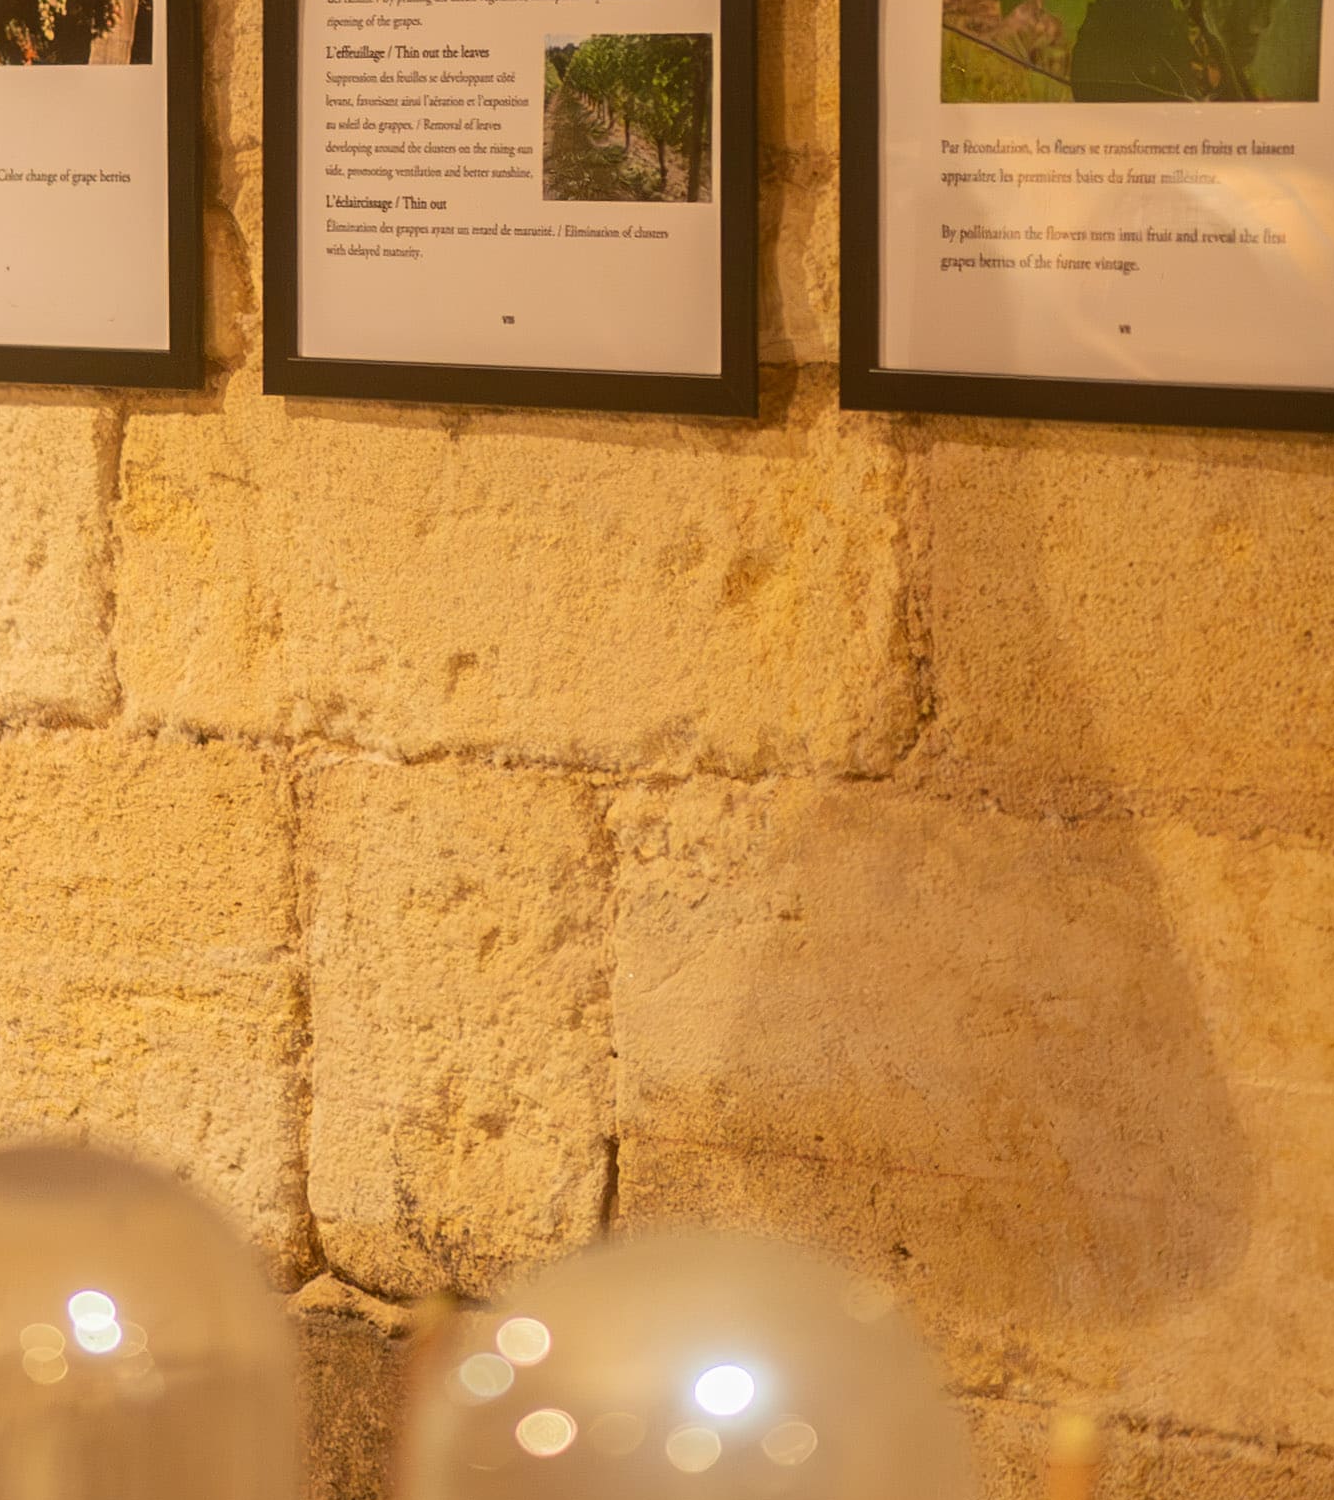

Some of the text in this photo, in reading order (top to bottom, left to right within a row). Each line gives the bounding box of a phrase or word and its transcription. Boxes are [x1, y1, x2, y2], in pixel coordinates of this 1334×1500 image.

[325, 45, 385, 62] L'effeuillage
[394, 45, 419, 58] Thin
[422, 49, 439, 58] out
[442, 44, 458, 58] the
[460, 44, 489, 58] leaves
[25, 168, 57, 186] change
[59, 168, 70, 181] of
[70, 169, 97, 186] grape
[99, 169, 130, 182] berries
[326, 194, 392, 212] L'éclaircissage
[402, 195, 427, 209] Thin
[429, 200, 446, 209] out
